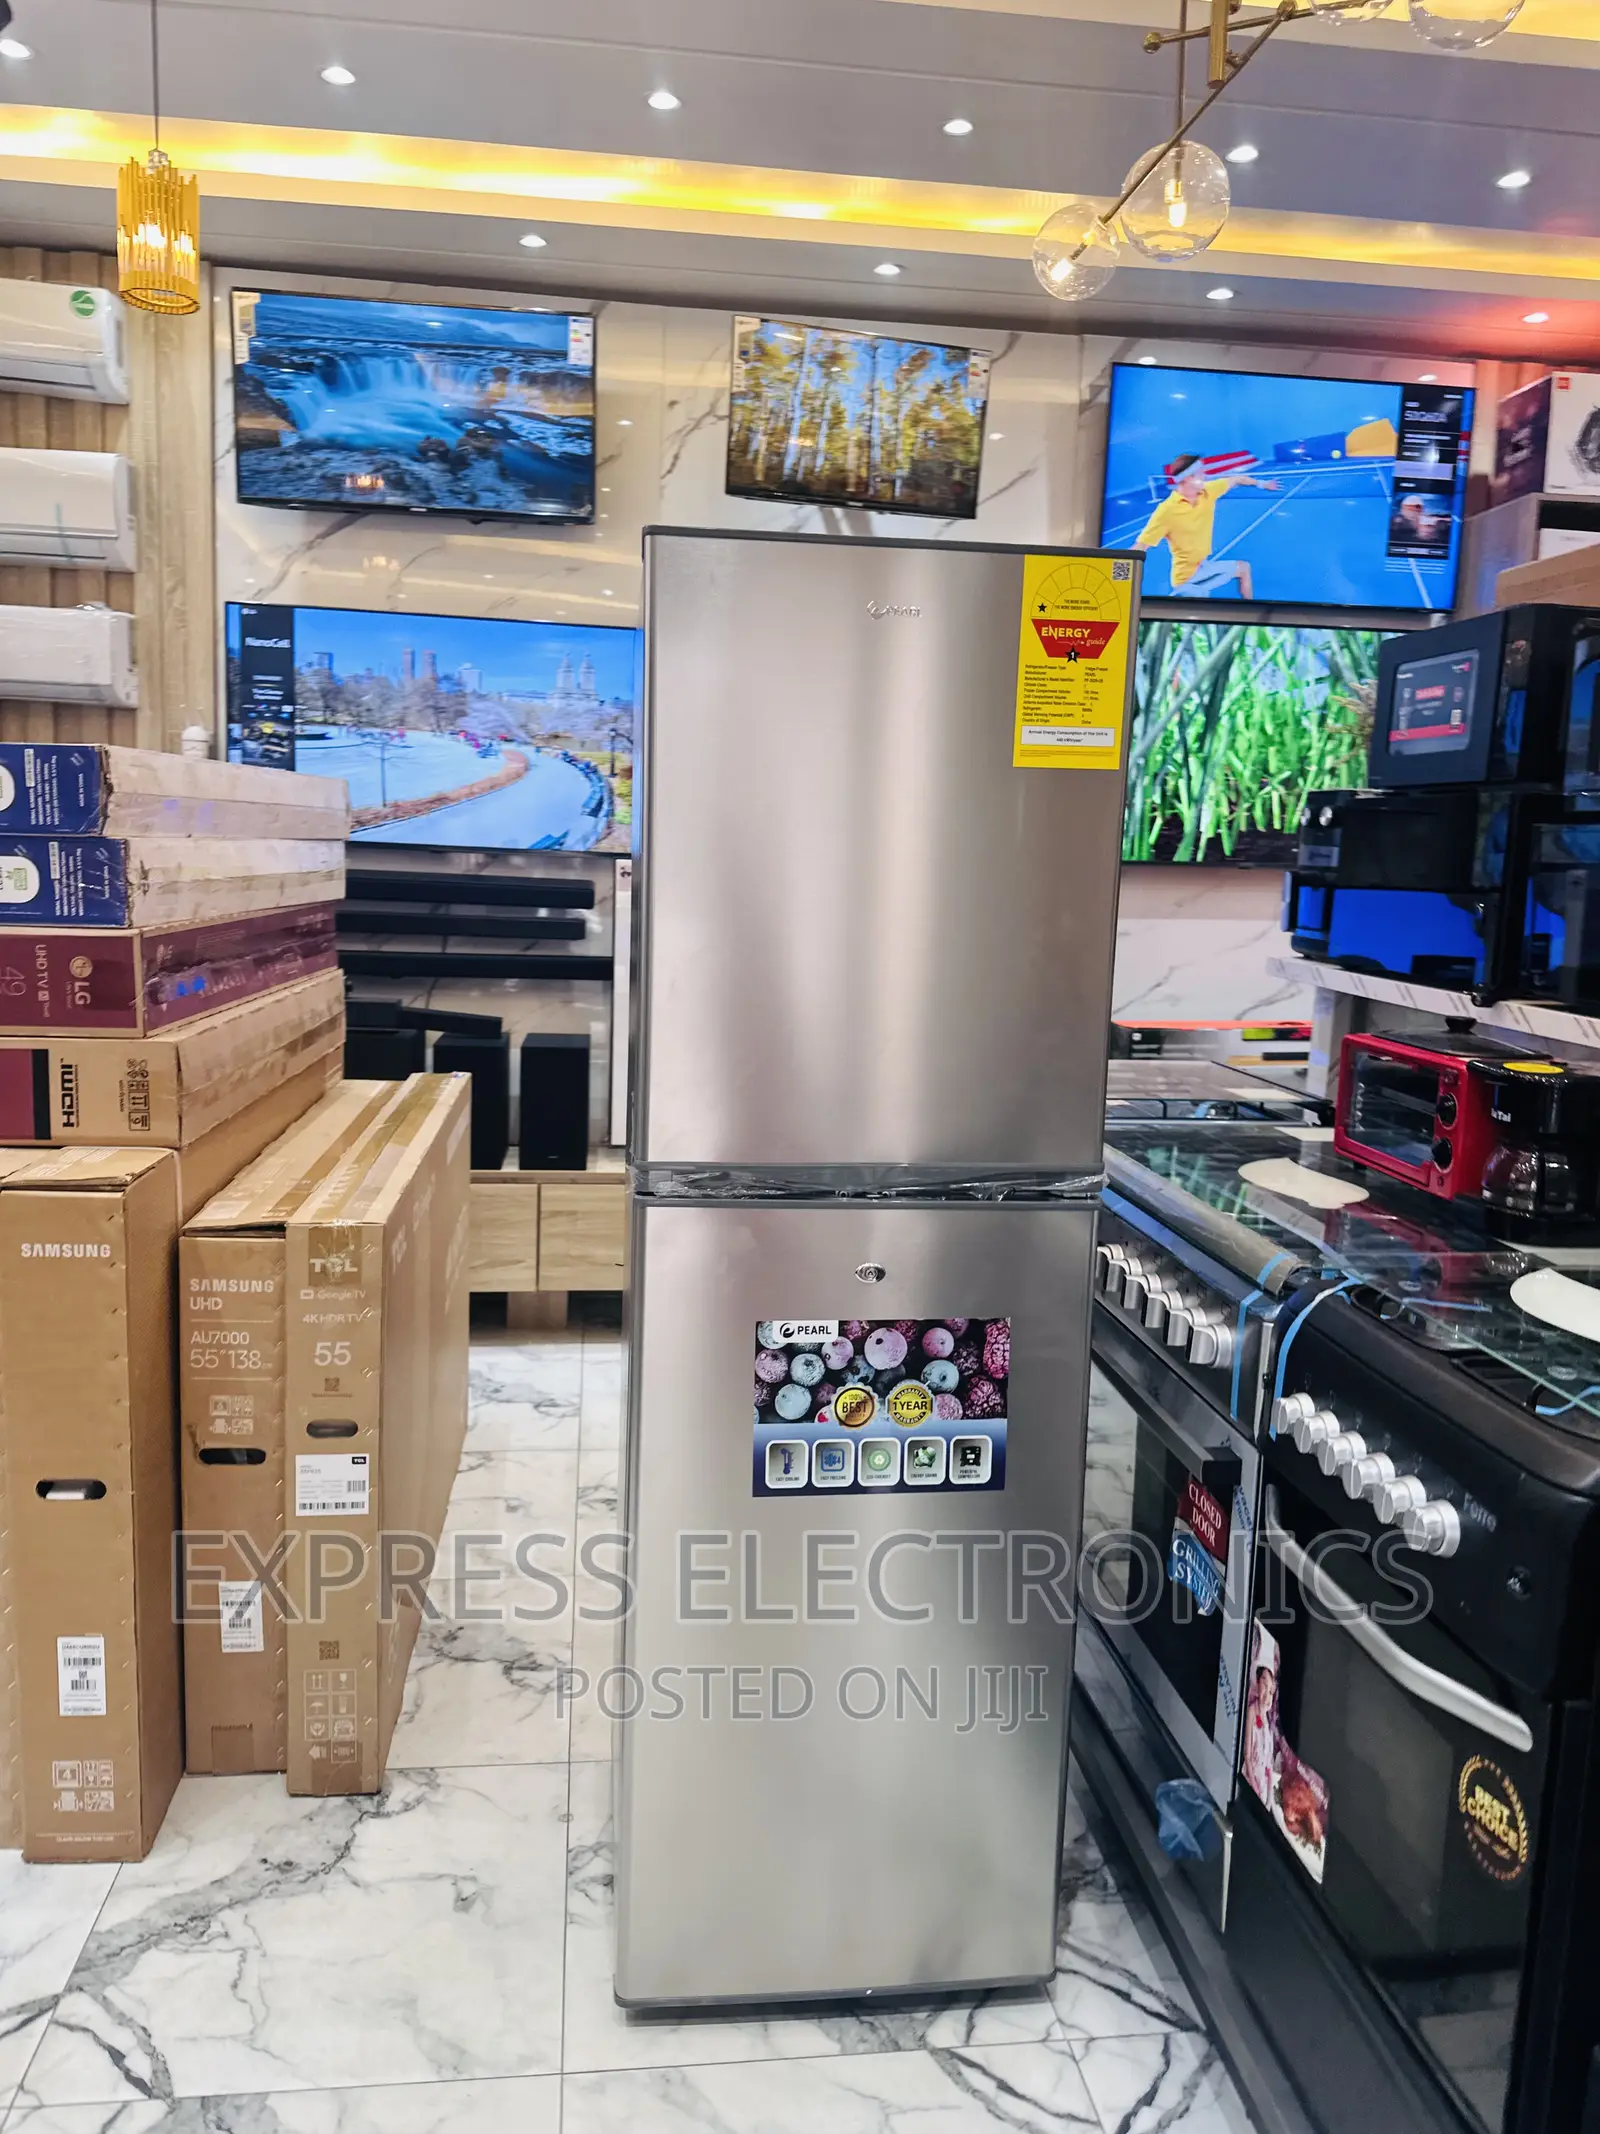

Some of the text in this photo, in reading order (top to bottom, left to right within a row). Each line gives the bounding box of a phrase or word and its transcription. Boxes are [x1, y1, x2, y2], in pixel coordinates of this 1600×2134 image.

[1041, 624, 1091, 640] ENERGY
[1086, 637, 1106, 648] guide
[1070, 651, 1076, 659] 1
[35, 944, 48, 970] UHD
[0, 966, 26, 996] 49
[37, 971, 49, 989] TV
[74, 981, 91, 1005] LG
[61, 1063, 75, 1128] HDMI
[21, 1243, 111, 1258] SAMSUNG
[190, 1278, 274, 1293] SAMSUNG
[317, 1290, 366, 1301] Google TV
[190, 1296, 223, 1311] UHD
[302, 1313, 363, 1324] 4K HDR TV
[190, 1330, 250, 1345] AU7000
[797, 1325, 832, 1335] PEARL
[314, 1341, 351, 1367] 55
[895, 1387, 927, 1401] WARRANTY
[842, 1401, 868, 1414] BEST
[893, 1400, 928, 1411] 1 YEAR
[894, 1411, 926, 1425] WARRANTY
[1188, 1483, 1222, 1529] CLOSED
[1192, 1507, 1215, 1547] DOOR
[1172, 1539, 1220, 1598] GRILLING
[1467, 1796, 1518, 1852] CHOICE
